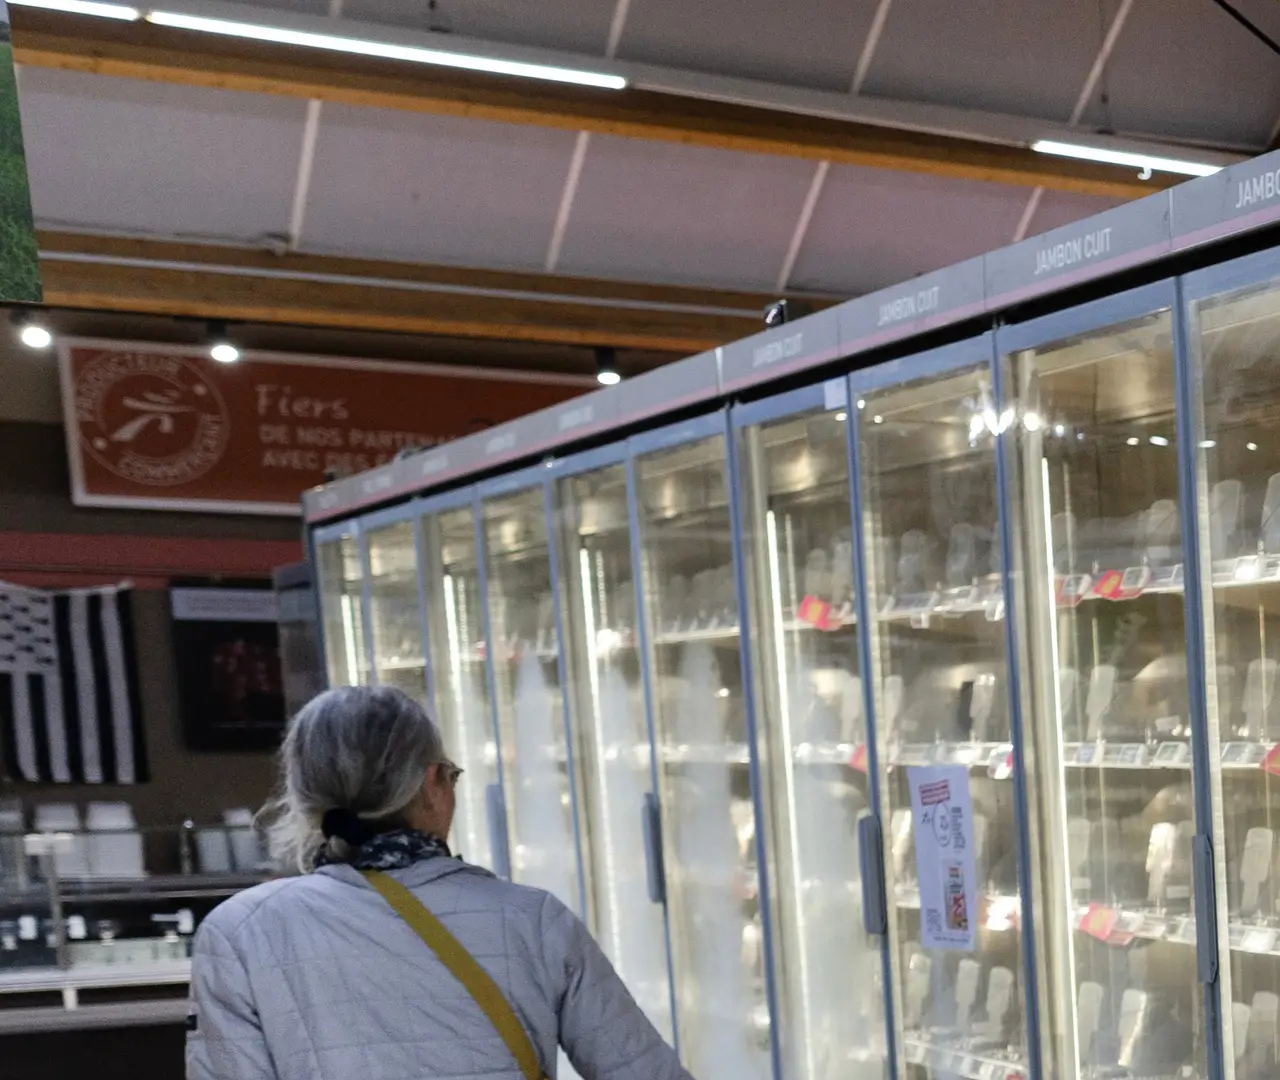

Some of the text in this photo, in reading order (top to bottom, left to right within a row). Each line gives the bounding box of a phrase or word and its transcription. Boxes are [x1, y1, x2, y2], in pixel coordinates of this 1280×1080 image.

[1034, 228, 1113, 276] JAMBON CUIT
[877, 286, 940, 328] JAMBON CUIT
[254, 384, 349, 420] Fiers
